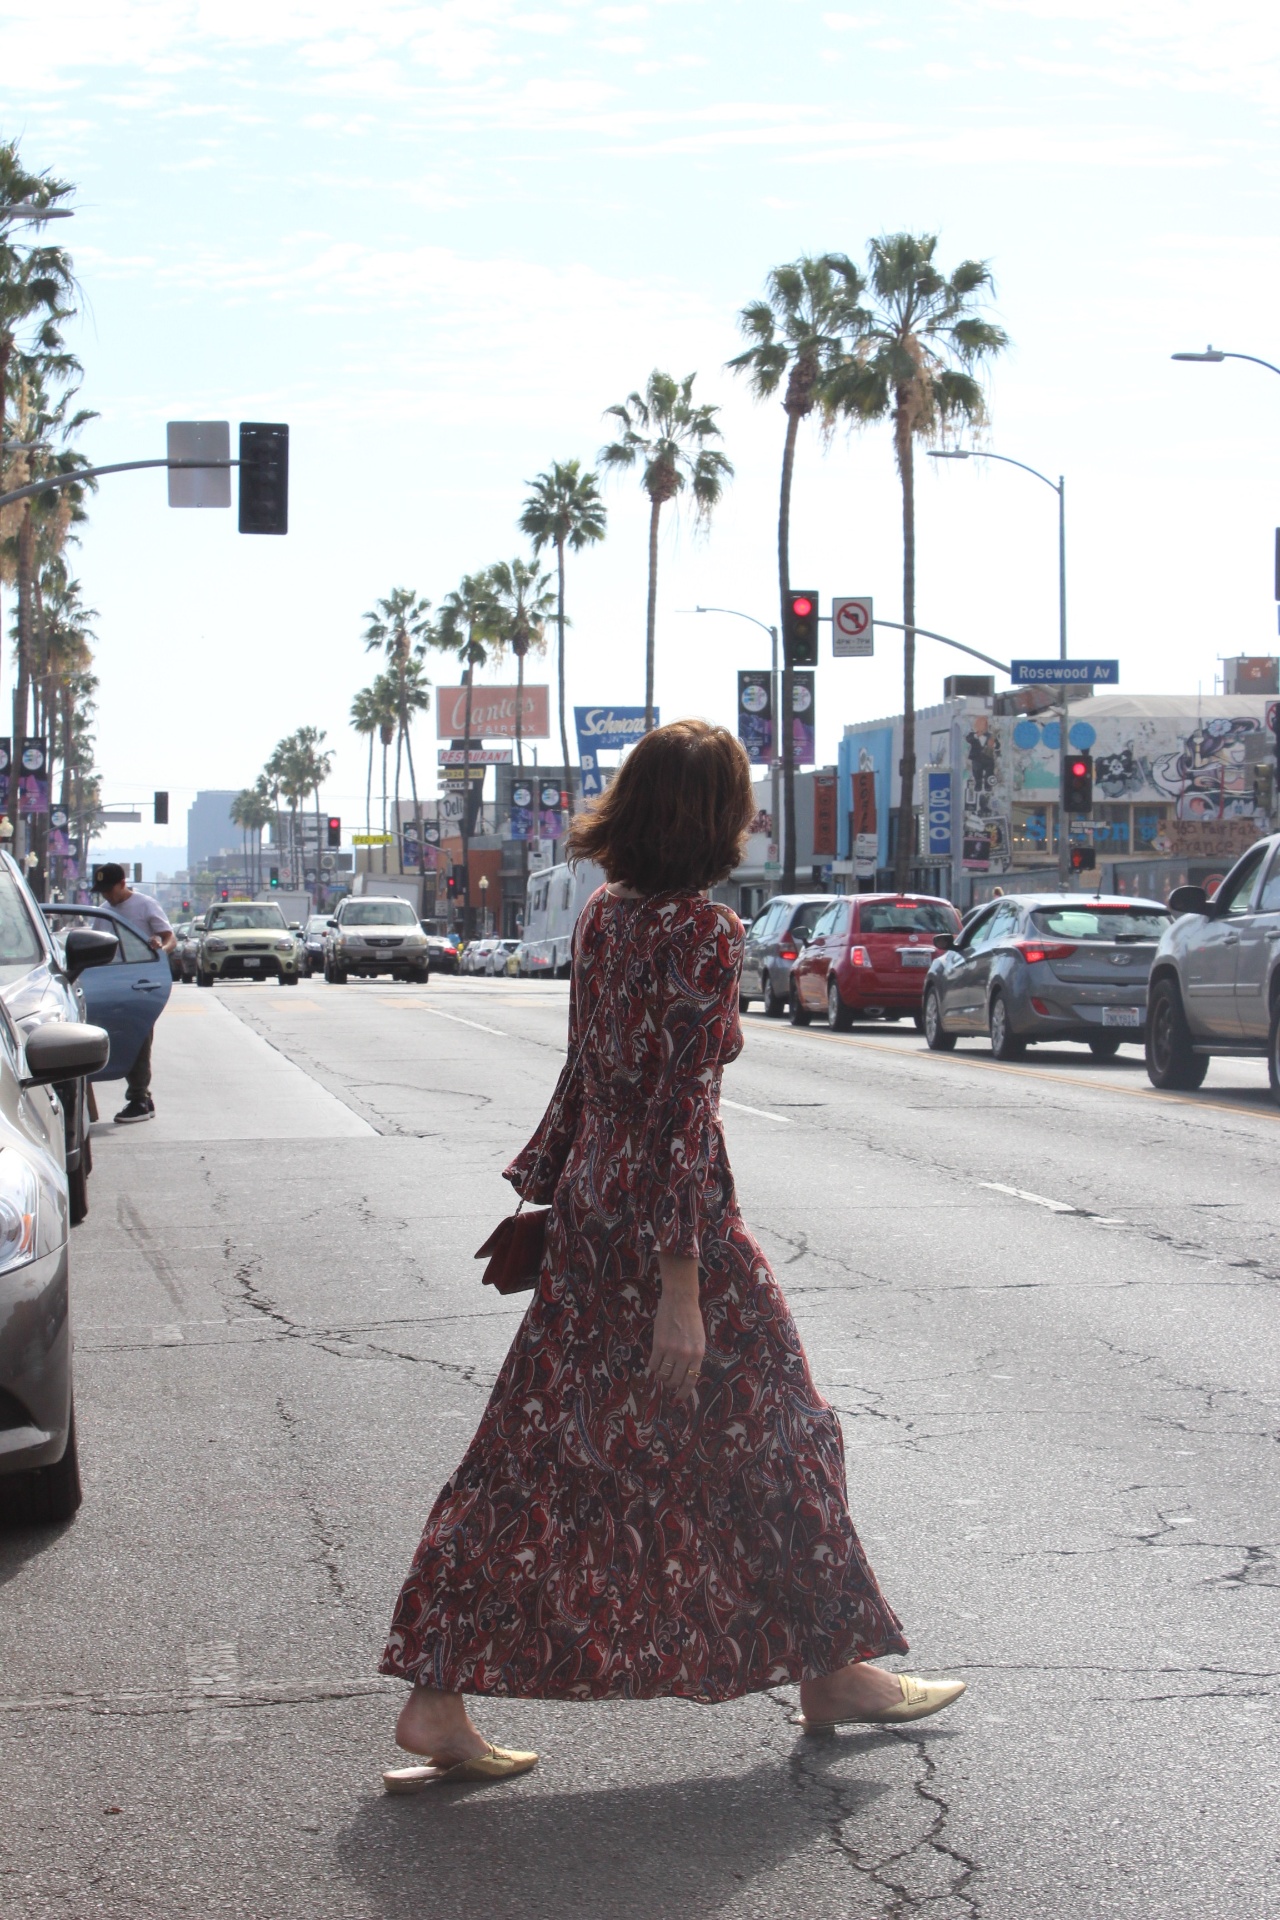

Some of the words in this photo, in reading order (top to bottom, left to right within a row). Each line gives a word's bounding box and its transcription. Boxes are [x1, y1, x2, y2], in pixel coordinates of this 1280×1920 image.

[1019, 666, 1088, 679] Rosewood
[1093, 666, 1110, 679] Av
[451, 691, 535, 730] Cantes
[581, 709, 657, 736] Schwar
[441, 751, 509, 762] RESAURANT
[580, 755, 600, 799] BA
[443, 797, 463, 817] Deli
[930, 788, 950, 840] goo
[355, 836, 369, 844] PED
[373, 836, 390, 844] XING
[1170, 838, 1234, 854] ntrance
